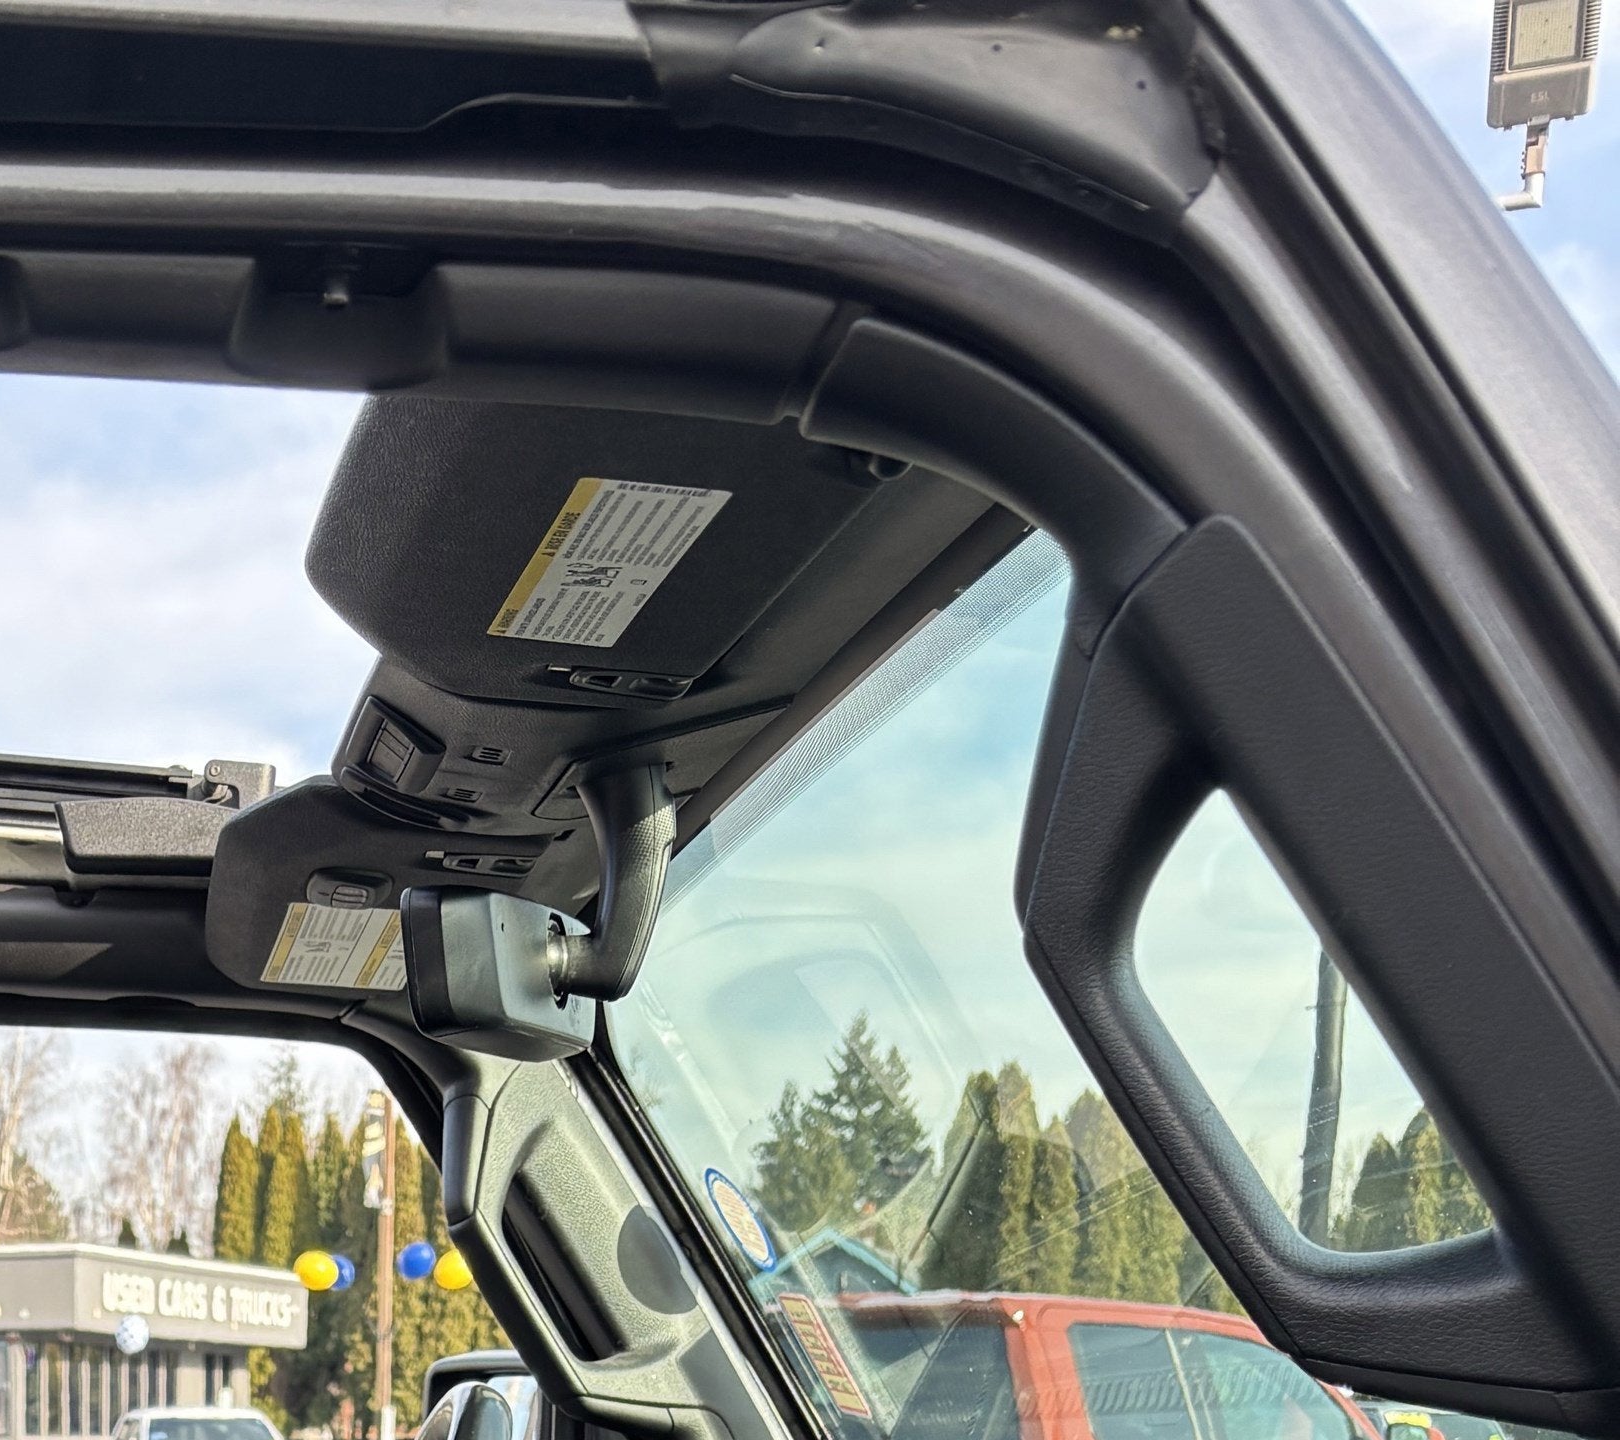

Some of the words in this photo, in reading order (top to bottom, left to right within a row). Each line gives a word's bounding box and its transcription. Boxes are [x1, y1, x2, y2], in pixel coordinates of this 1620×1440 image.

[102, 1271, 155, 1315] USED
[158, 1277, 208, 1320] CARS
[211, 1284, 227, 1323] &
[230, 1286, 292, 1328] TRUCKS
